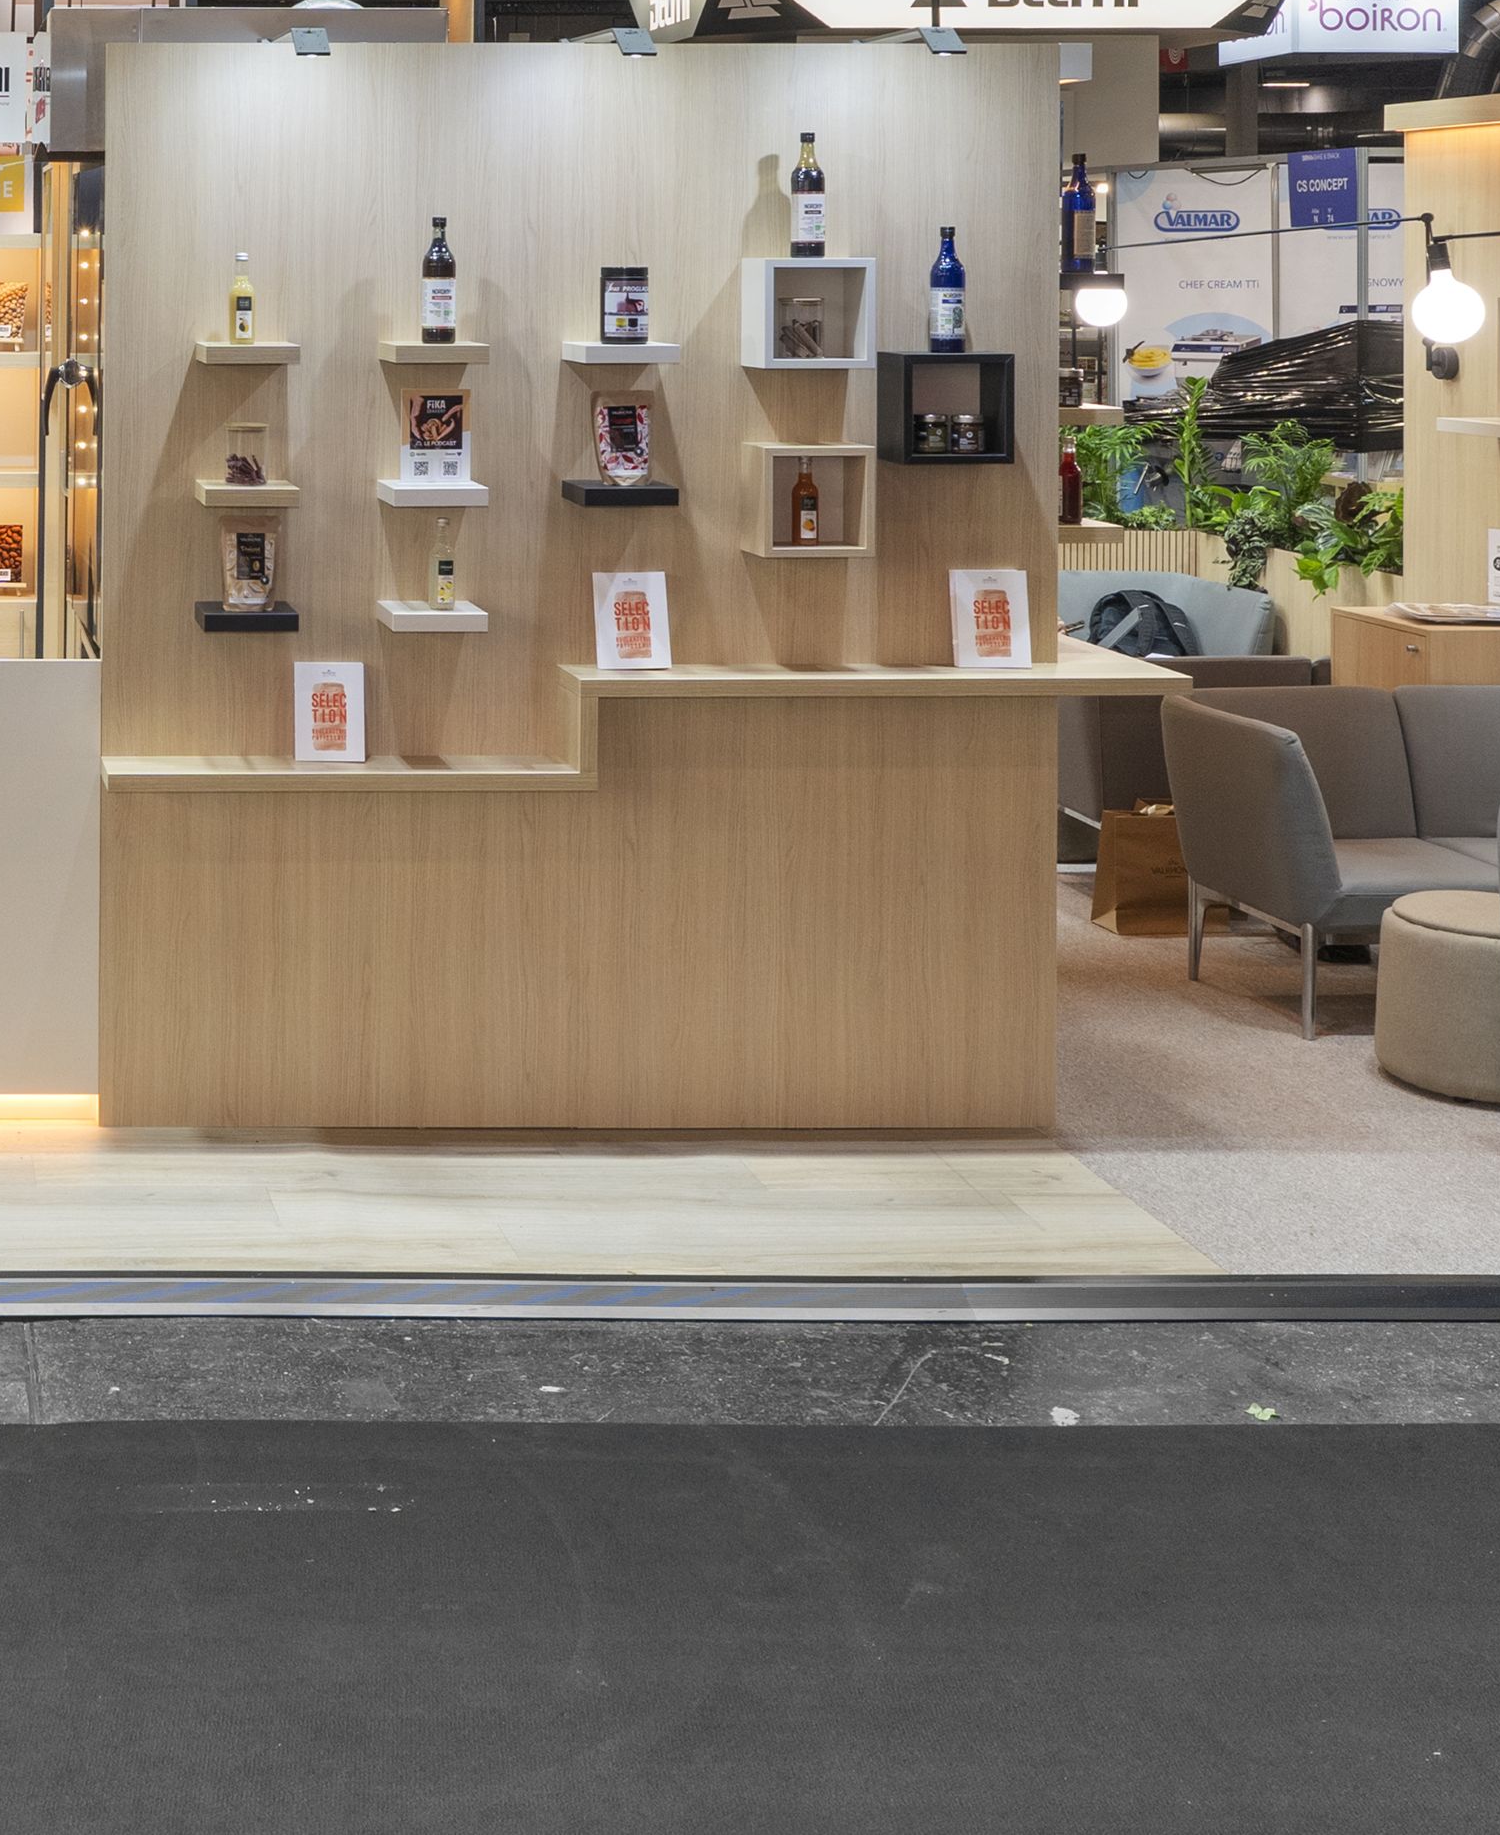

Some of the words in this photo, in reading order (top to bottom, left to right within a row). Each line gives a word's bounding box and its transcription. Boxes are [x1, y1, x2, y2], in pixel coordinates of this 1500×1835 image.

[1296, 179, 1308, 192] CS
[1309, 177, 1349, 192] CONCEPT
[1163, 210, 1232, 227] VALMAR
[1179, 280, 1204, 289] CHEF
[1207, 280, 1242, 289] CREAM
[613, 597, 650, 617] SÉLEC
[972, 595, 1010, 615] SÉLEC
[614, 617, 651, 632] TION
[973, 615, 1010, 631] TION
[311, 689, 347, 708] SÉLEC
[311, 708, 347, 724] TION
